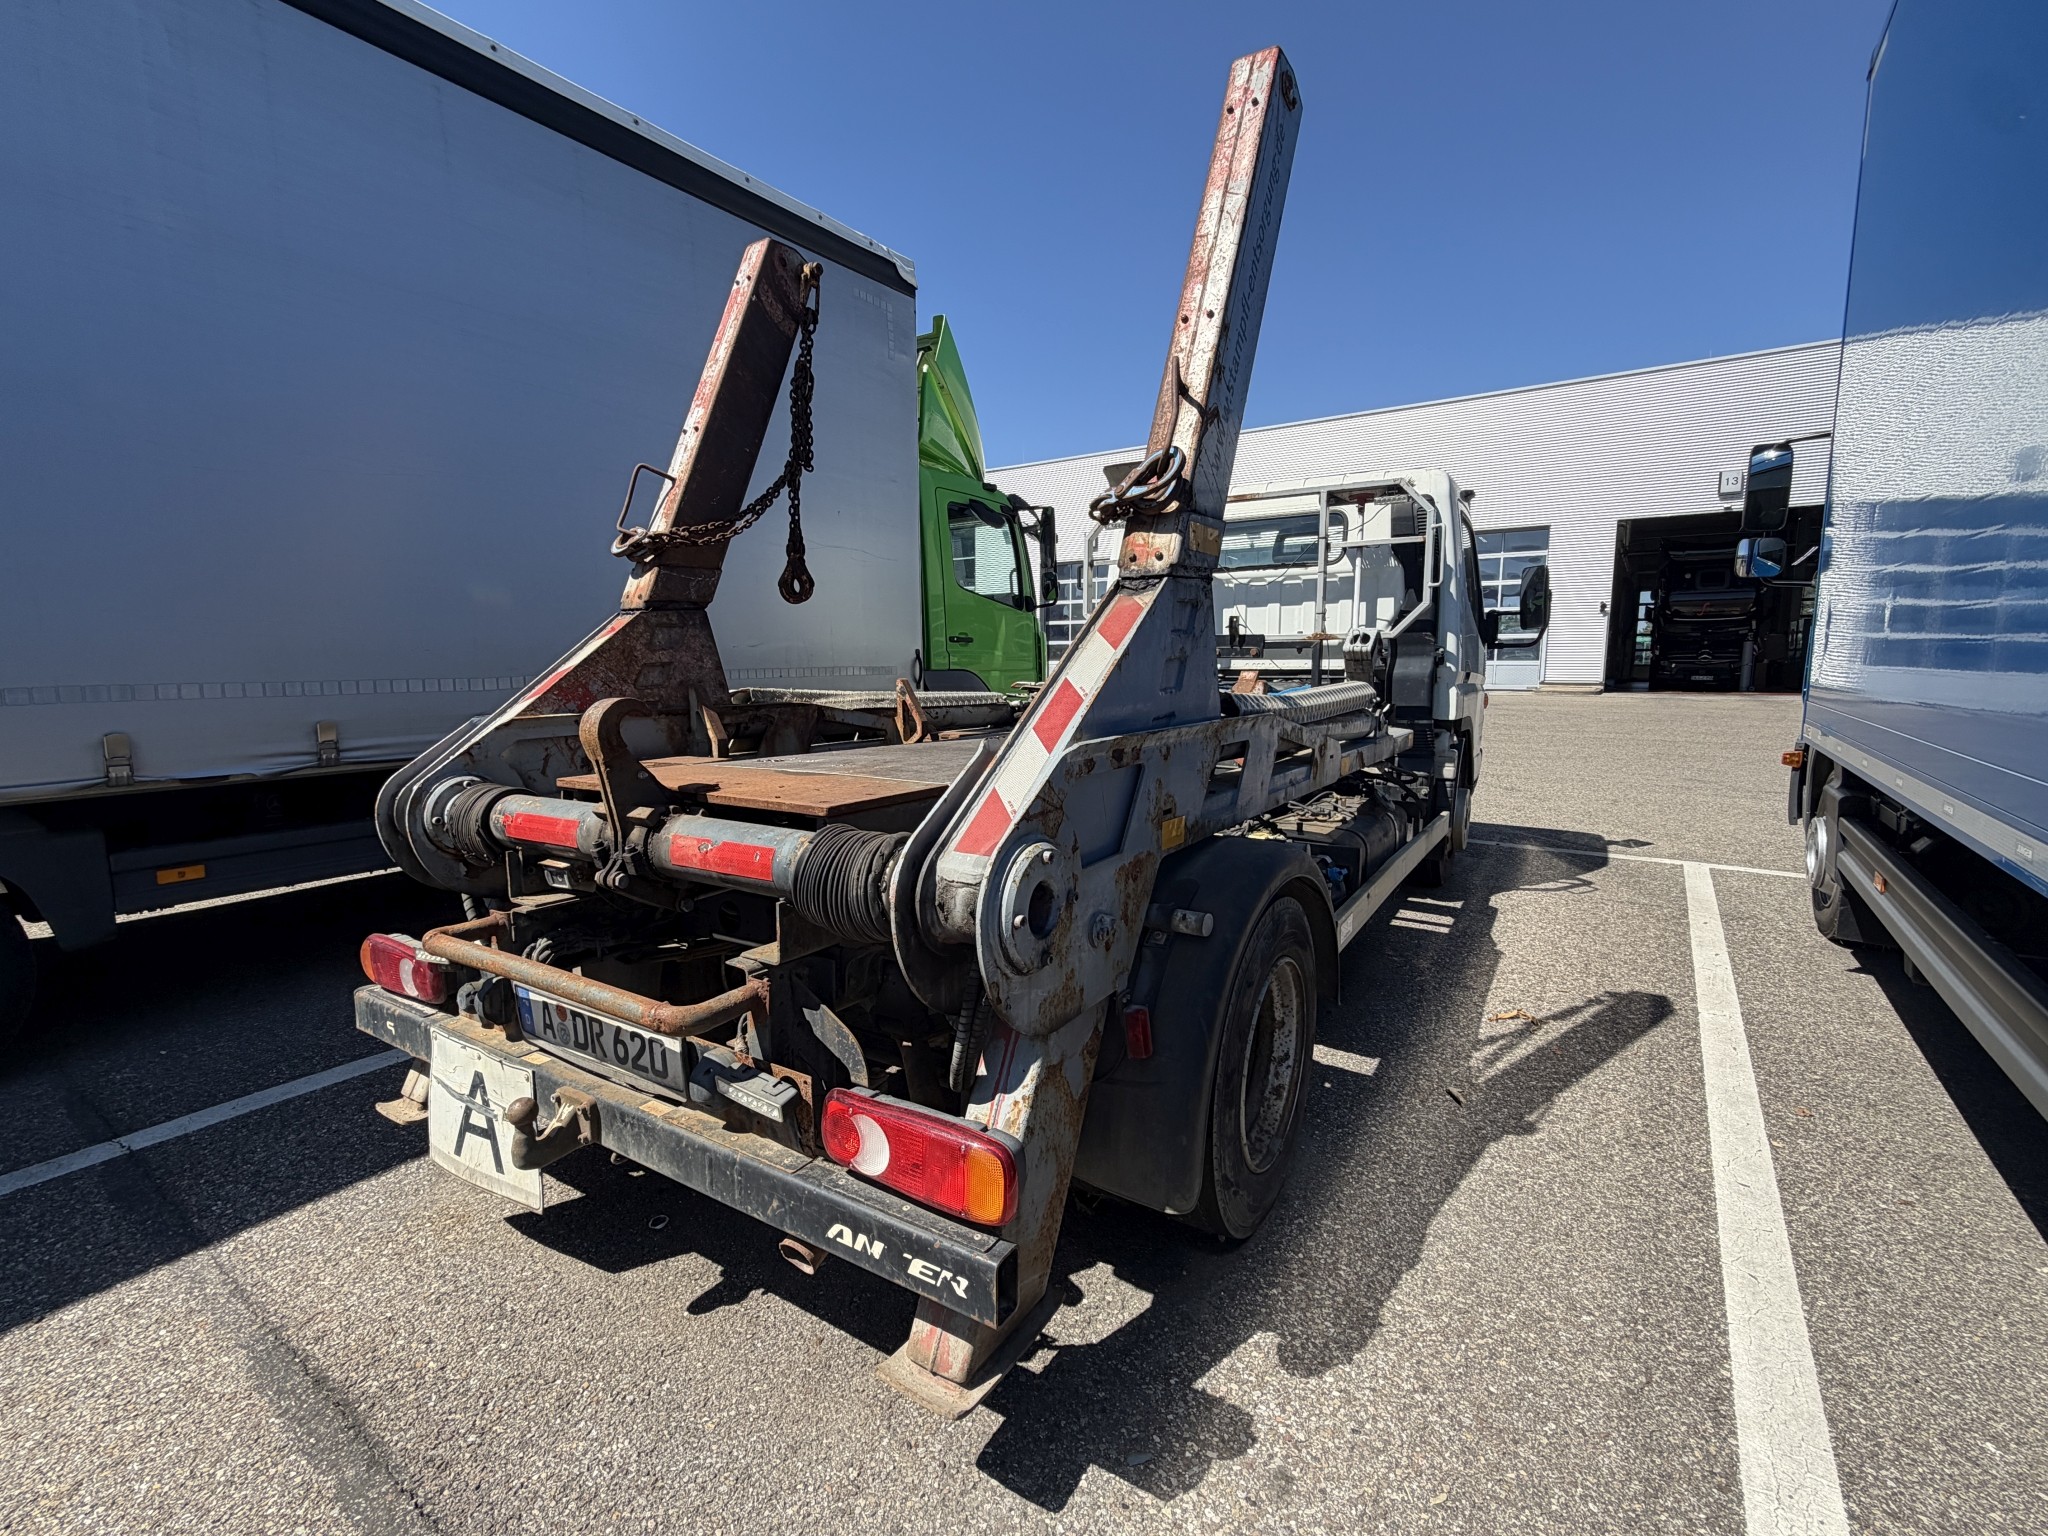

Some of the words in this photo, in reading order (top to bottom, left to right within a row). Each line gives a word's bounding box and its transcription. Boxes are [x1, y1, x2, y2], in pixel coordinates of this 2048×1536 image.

[1725, 476, 1739, 486] 13
[542, 1000, 557, 1040] A
[570, 1009, 608, 1059] DR
[613, 1025, 669, 1080] 620
[453, 1070, 504, 1175] A
